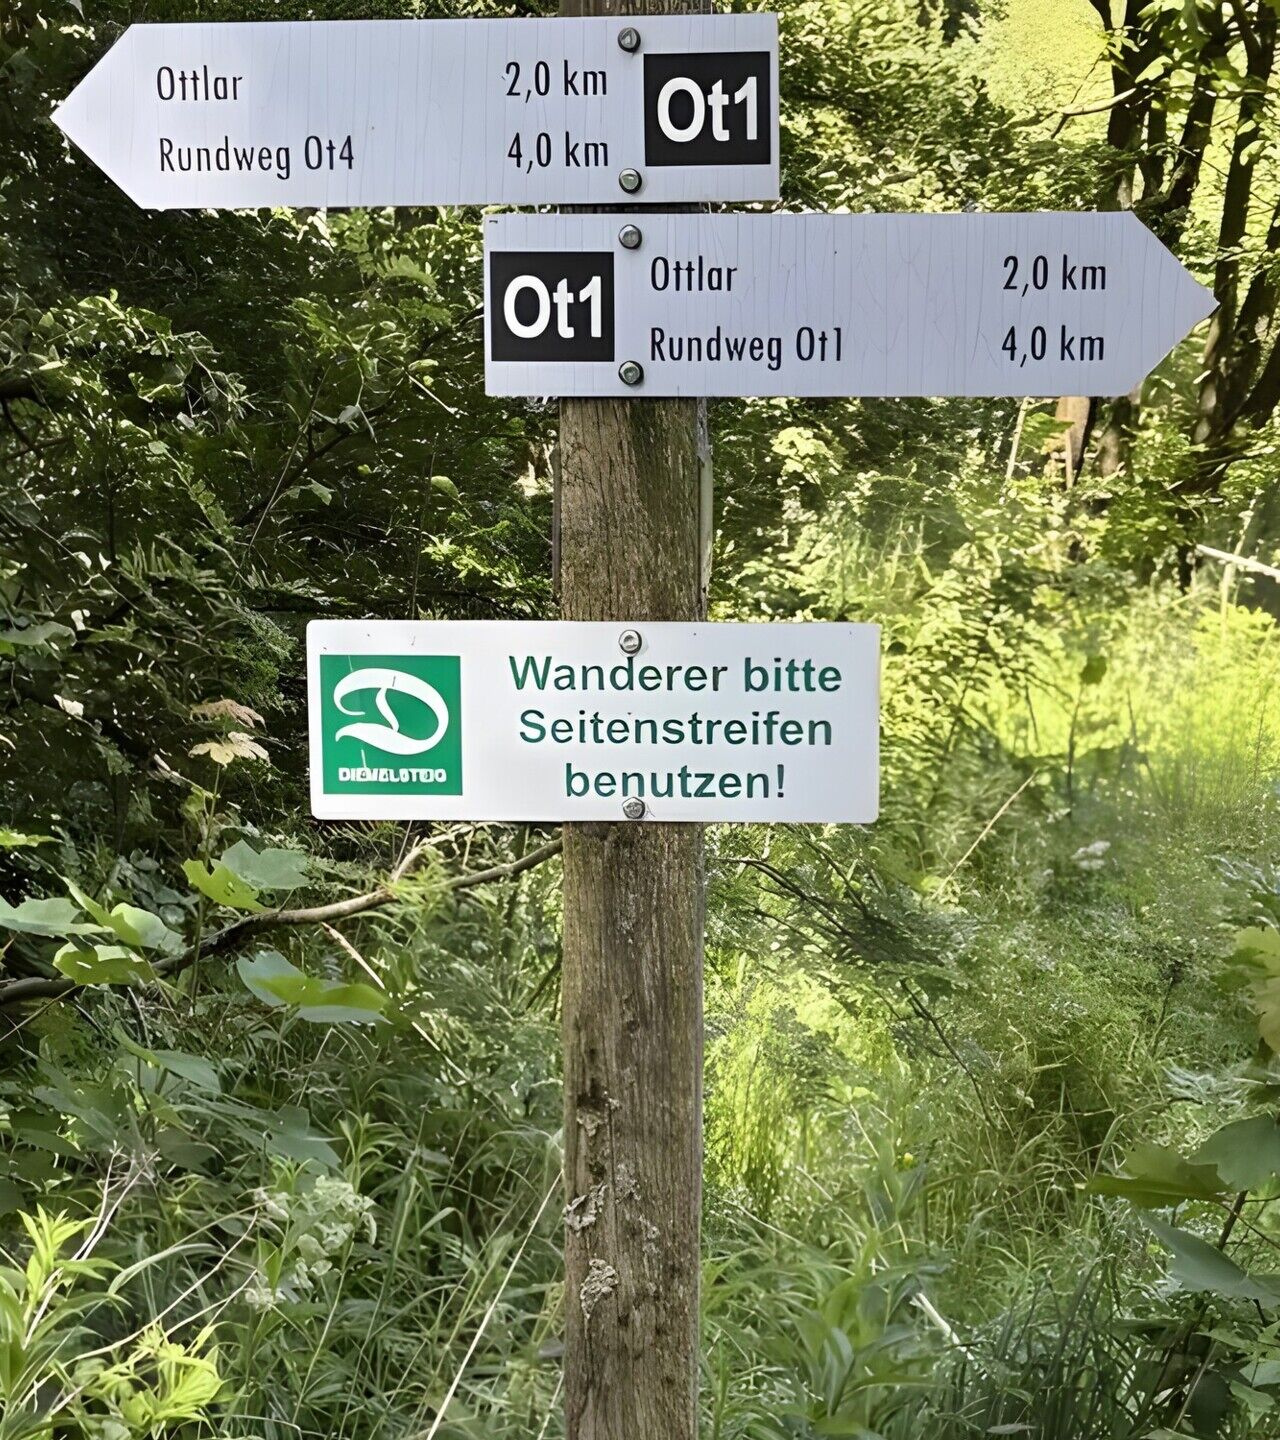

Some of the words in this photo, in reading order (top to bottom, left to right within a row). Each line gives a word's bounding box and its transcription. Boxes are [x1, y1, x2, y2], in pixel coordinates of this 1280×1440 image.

[156, 64, 243, 101] Ottlar
[506, 60, 551, 104] 2,0
[563, 59, 608, 96] km
[656, 76, 759, 143] Ot1
[159, 135, 291, 181] Rundweg
[304, 134, 355, 171] Ot4
[507, 131, 552, 175] 4,0
[564, 130, 609, 168] km
[650, 254, 738, 292] Ottlar
[1002, 254, 1049, 298] 2,0
[1061, 253, 1107, 291] km
[503, 274, 604, 339] Ot1
[650, 325, 782, 372] Rundweg
[795, 326, 842, 362] Ot1
[1001, 325, 1047, 369] 4,0
[1060, 323, 1105, 362] km
[509, 655, 729, 693] Wanderer
[743, 657, 842, 693] bitte
[519, 708, 832, 746] Seitenstreifen
[564, 762, 786, 799] benutzen!
